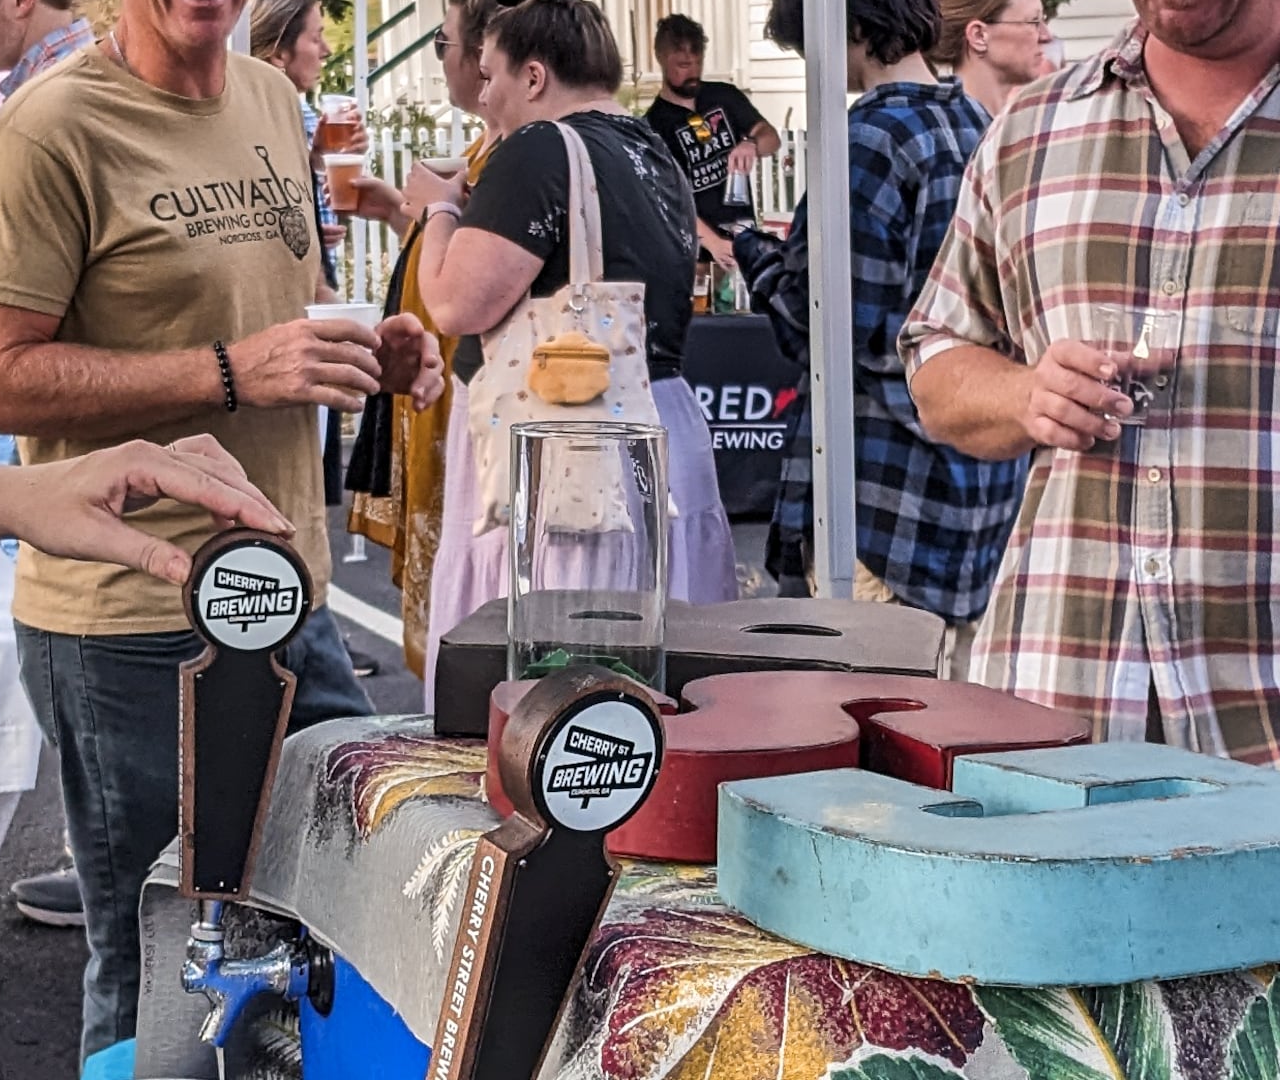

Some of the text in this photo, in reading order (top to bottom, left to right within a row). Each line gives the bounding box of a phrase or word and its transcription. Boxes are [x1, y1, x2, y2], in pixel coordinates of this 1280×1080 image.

[186, 211, 251, 239] BREWING
[695, 386, 773, 421] RED
[217, 571, 277, 592] CHERRY ST
[209, 590, 294, 617] BREWING
[569, 731, 630, 758] CHERRY ST
[552, 757, 646, 789] BREWING
[466, 855, 495, 945] CHERRY
[449, 945, 476, 1019] STREET
